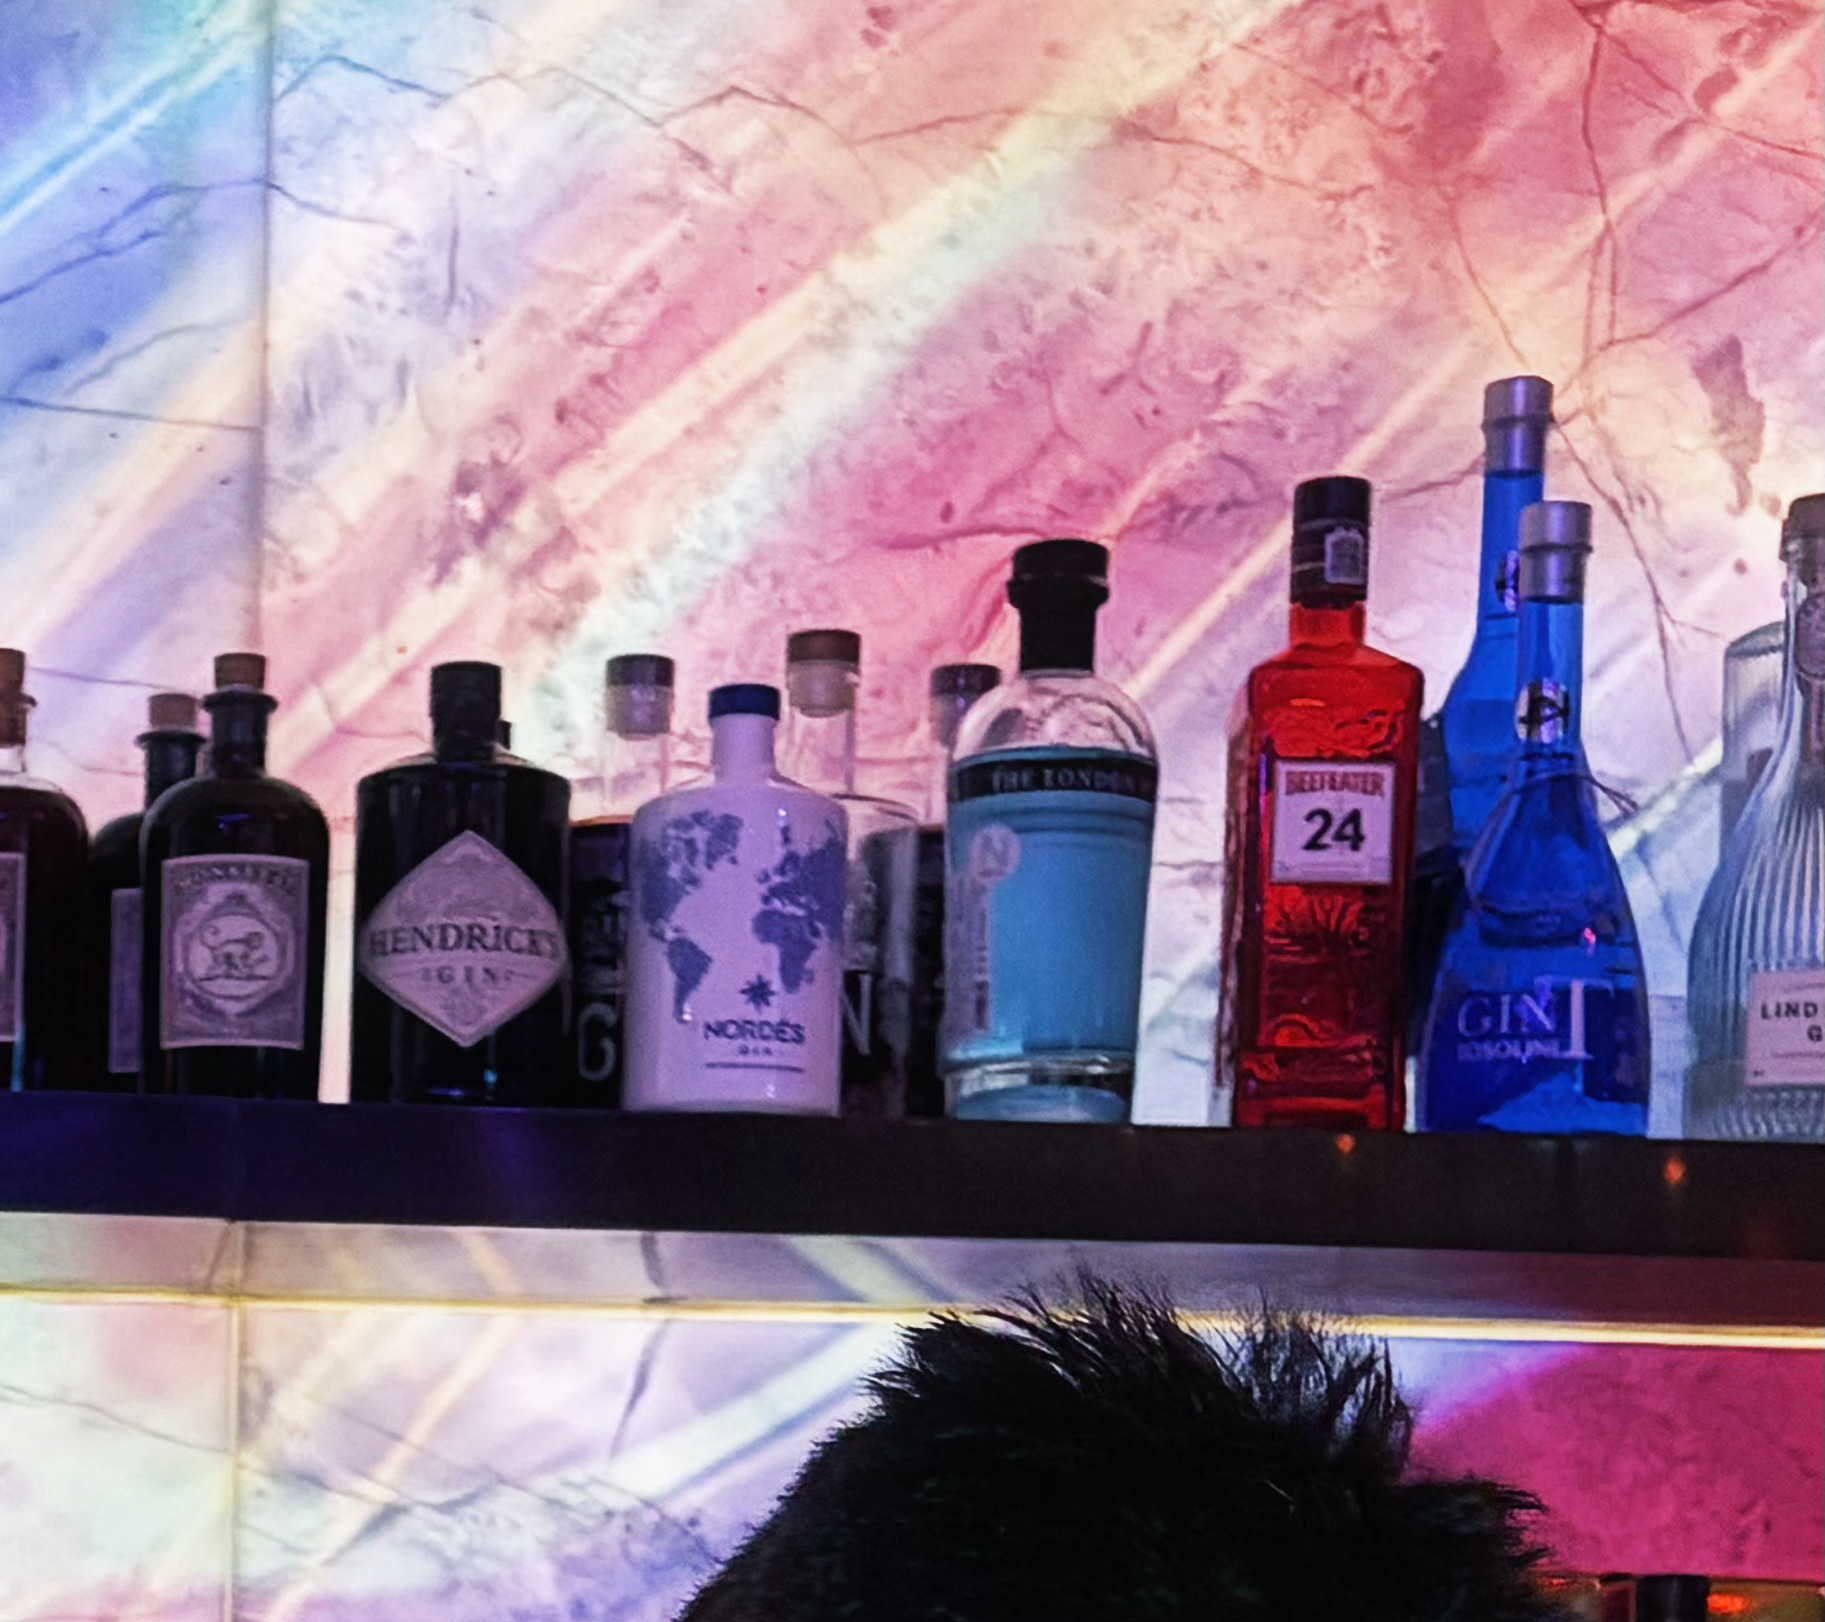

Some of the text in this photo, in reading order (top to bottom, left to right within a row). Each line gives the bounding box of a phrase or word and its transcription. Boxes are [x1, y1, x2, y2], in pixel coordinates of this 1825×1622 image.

[1285, 770, 1385, 797] BEEFEATER
[1302, 808, 1365, 851] 24
[1761, 1001, 1818, 1020] LIND
